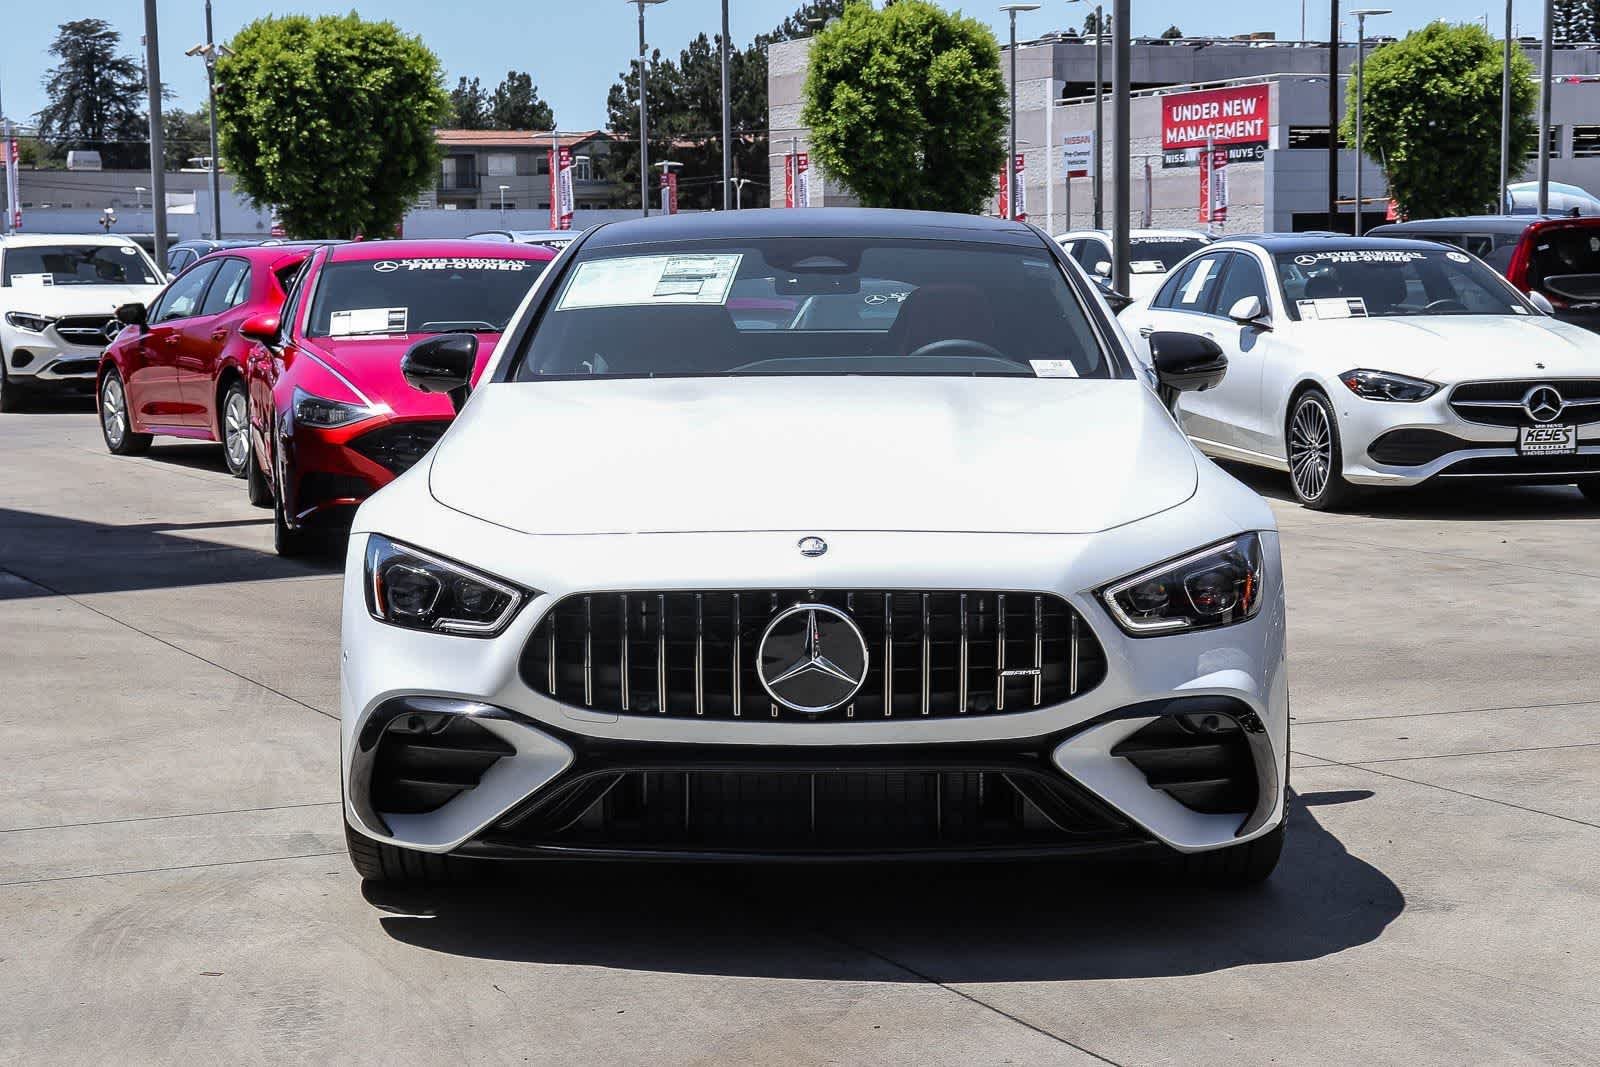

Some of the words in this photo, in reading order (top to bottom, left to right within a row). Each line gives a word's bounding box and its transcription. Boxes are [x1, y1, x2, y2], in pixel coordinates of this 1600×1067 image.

[1172, 102, 1219, 122] UNDER
[1222, 97, 1257, 117] NEW
[1166, 119, 1265, 144] MANAGEMENT
[1229, 148, 1254, 159] NUYS
[408, 263, 524, 271] PRE-OWNED
[1525, 429, 1573, 442] KEYES
